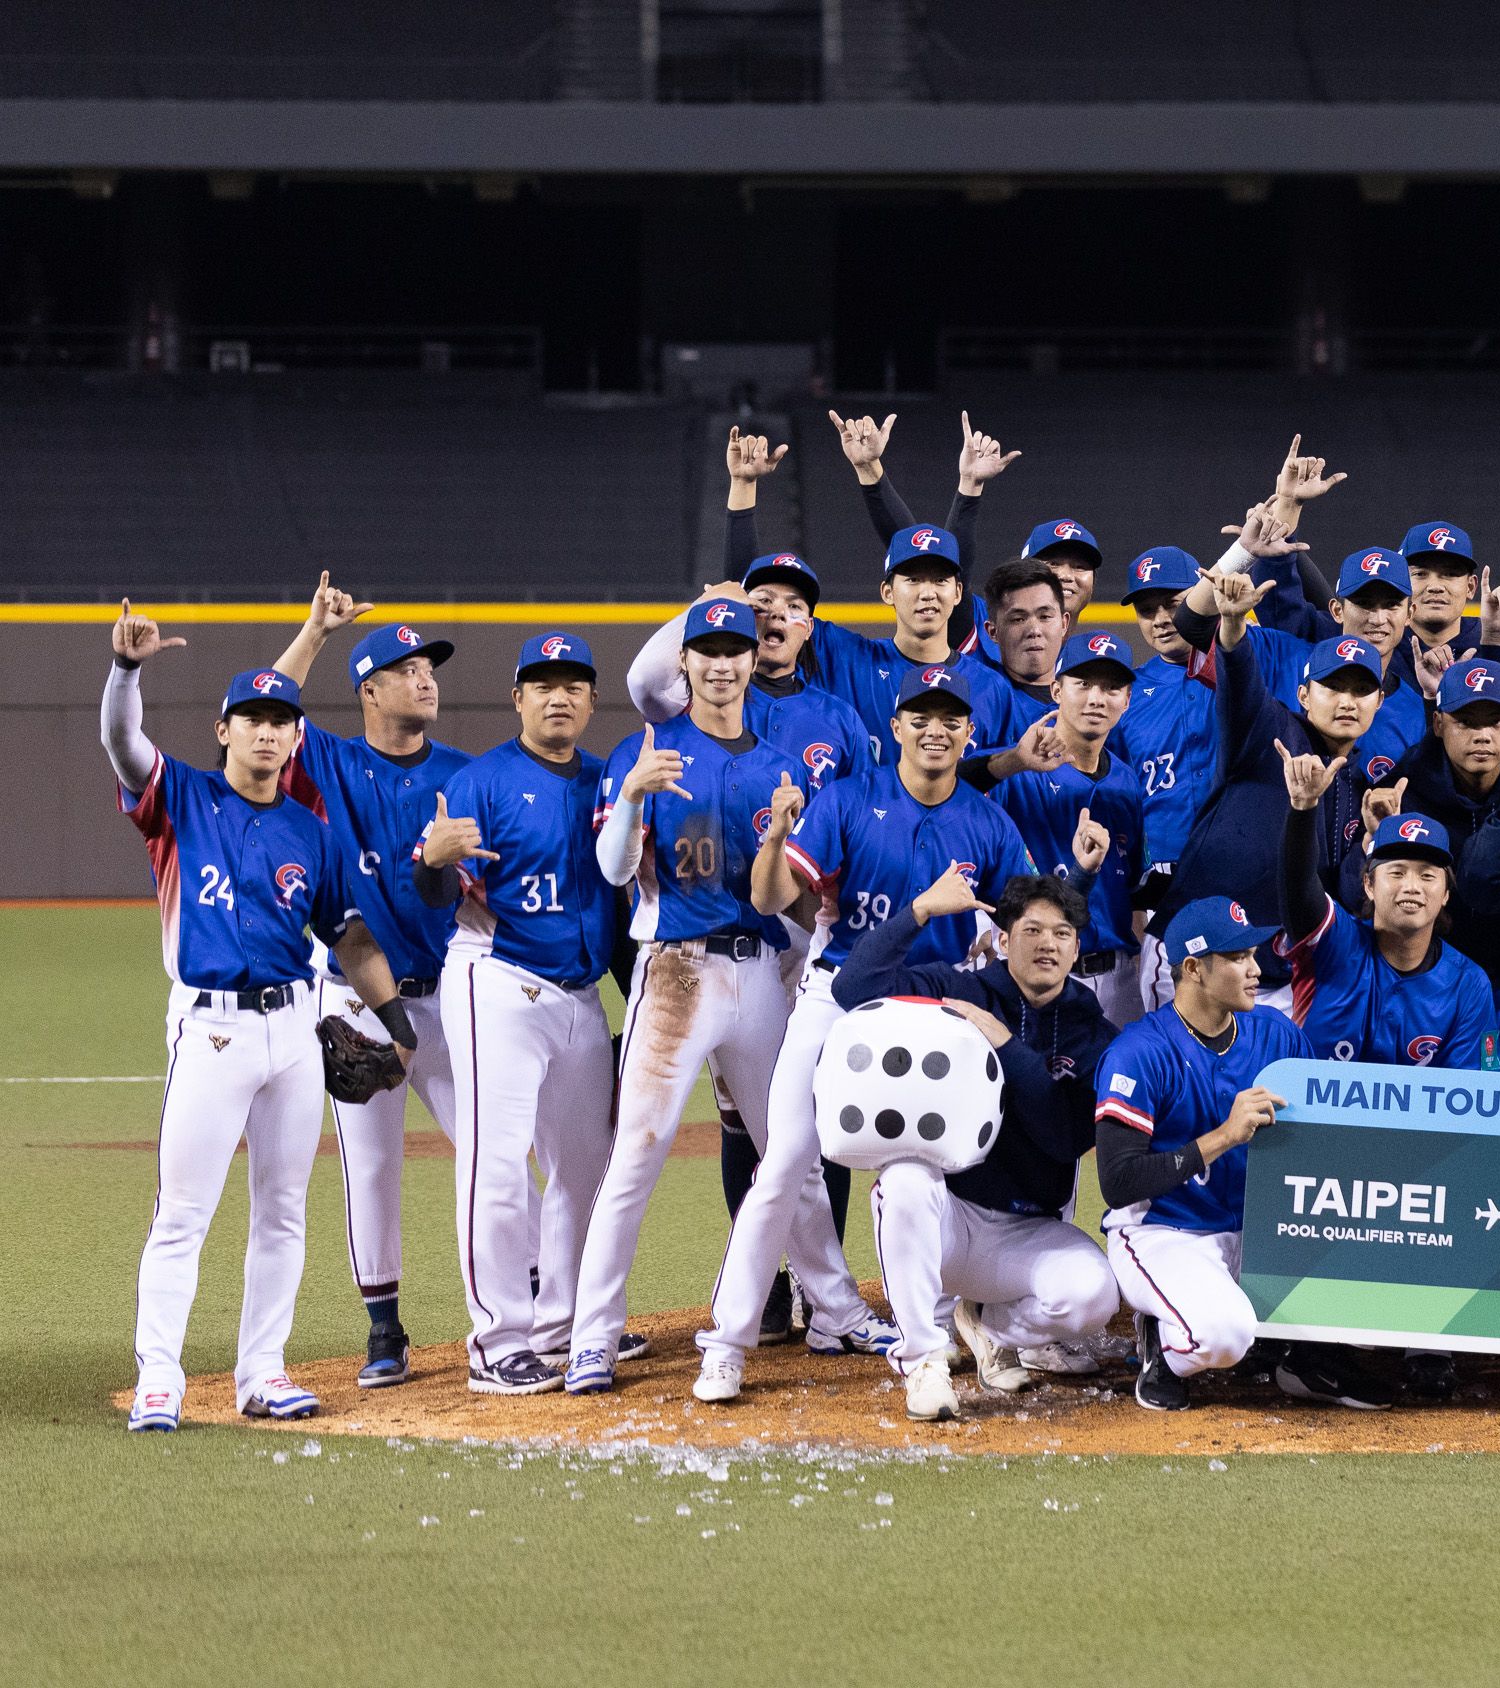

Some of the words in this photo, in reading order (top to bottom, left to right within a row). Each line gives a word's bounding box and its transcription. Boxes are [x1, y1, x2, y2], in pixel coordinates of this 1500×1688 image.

[1143, 753, 1176, 796] 23
[675, 838, 715, 879] 20
[199, 864, 234, 911] 24
[521, 873, 564, 912] 31
[848, 891, 891, 931] 39
[1306, 1078, 1411, 1112] MAIN
[1284, 1175, 1446, 1224] TAIPEI
[1277, 1222, 1319, 1239] POOL
[1323, 1227, 1404, 1244] QUALIFIER
[1407, 1231, 1453, 1247] TEAM
